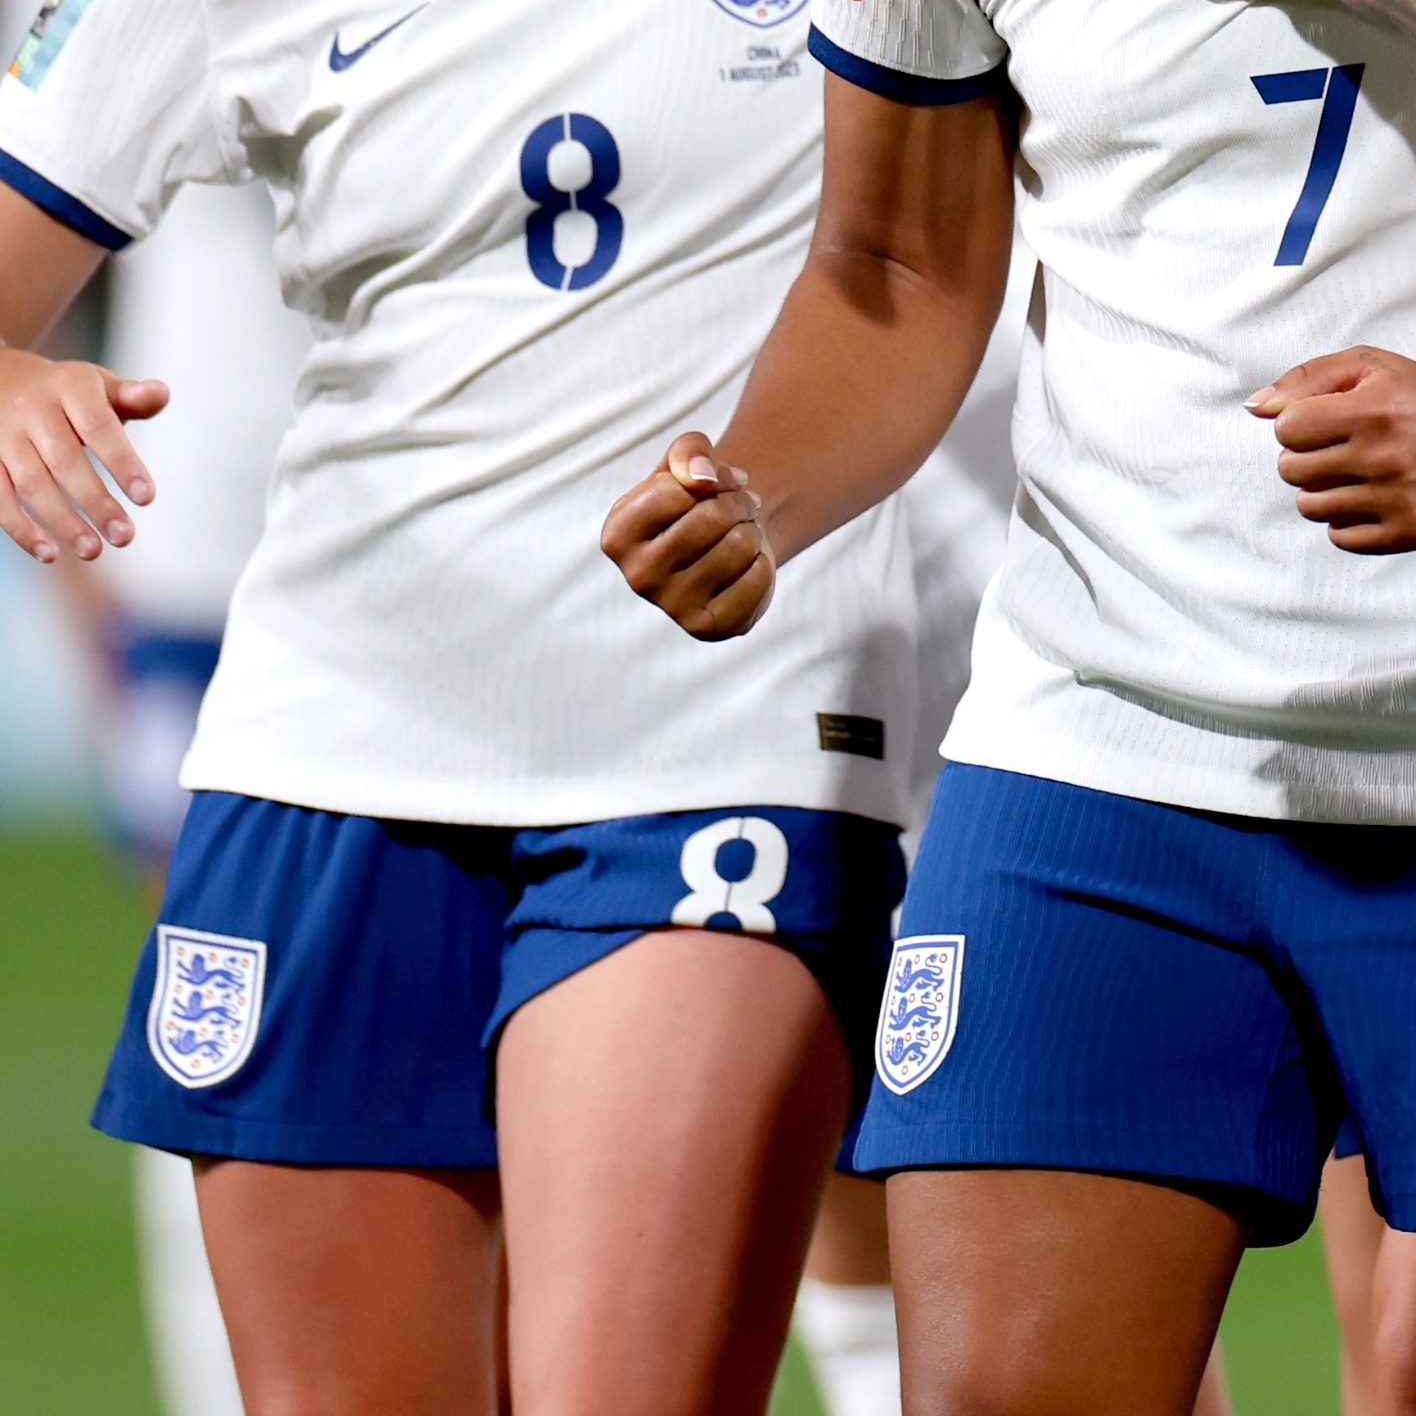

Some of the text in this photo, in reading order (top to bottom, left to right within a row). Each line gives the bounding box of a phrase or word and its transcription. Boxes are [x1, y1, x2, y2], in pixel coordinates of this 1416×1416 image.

[520, 113, 624, 291] 8
[1250, 63, 1366, 266] 7
[671, 817, 789, 933] 8
